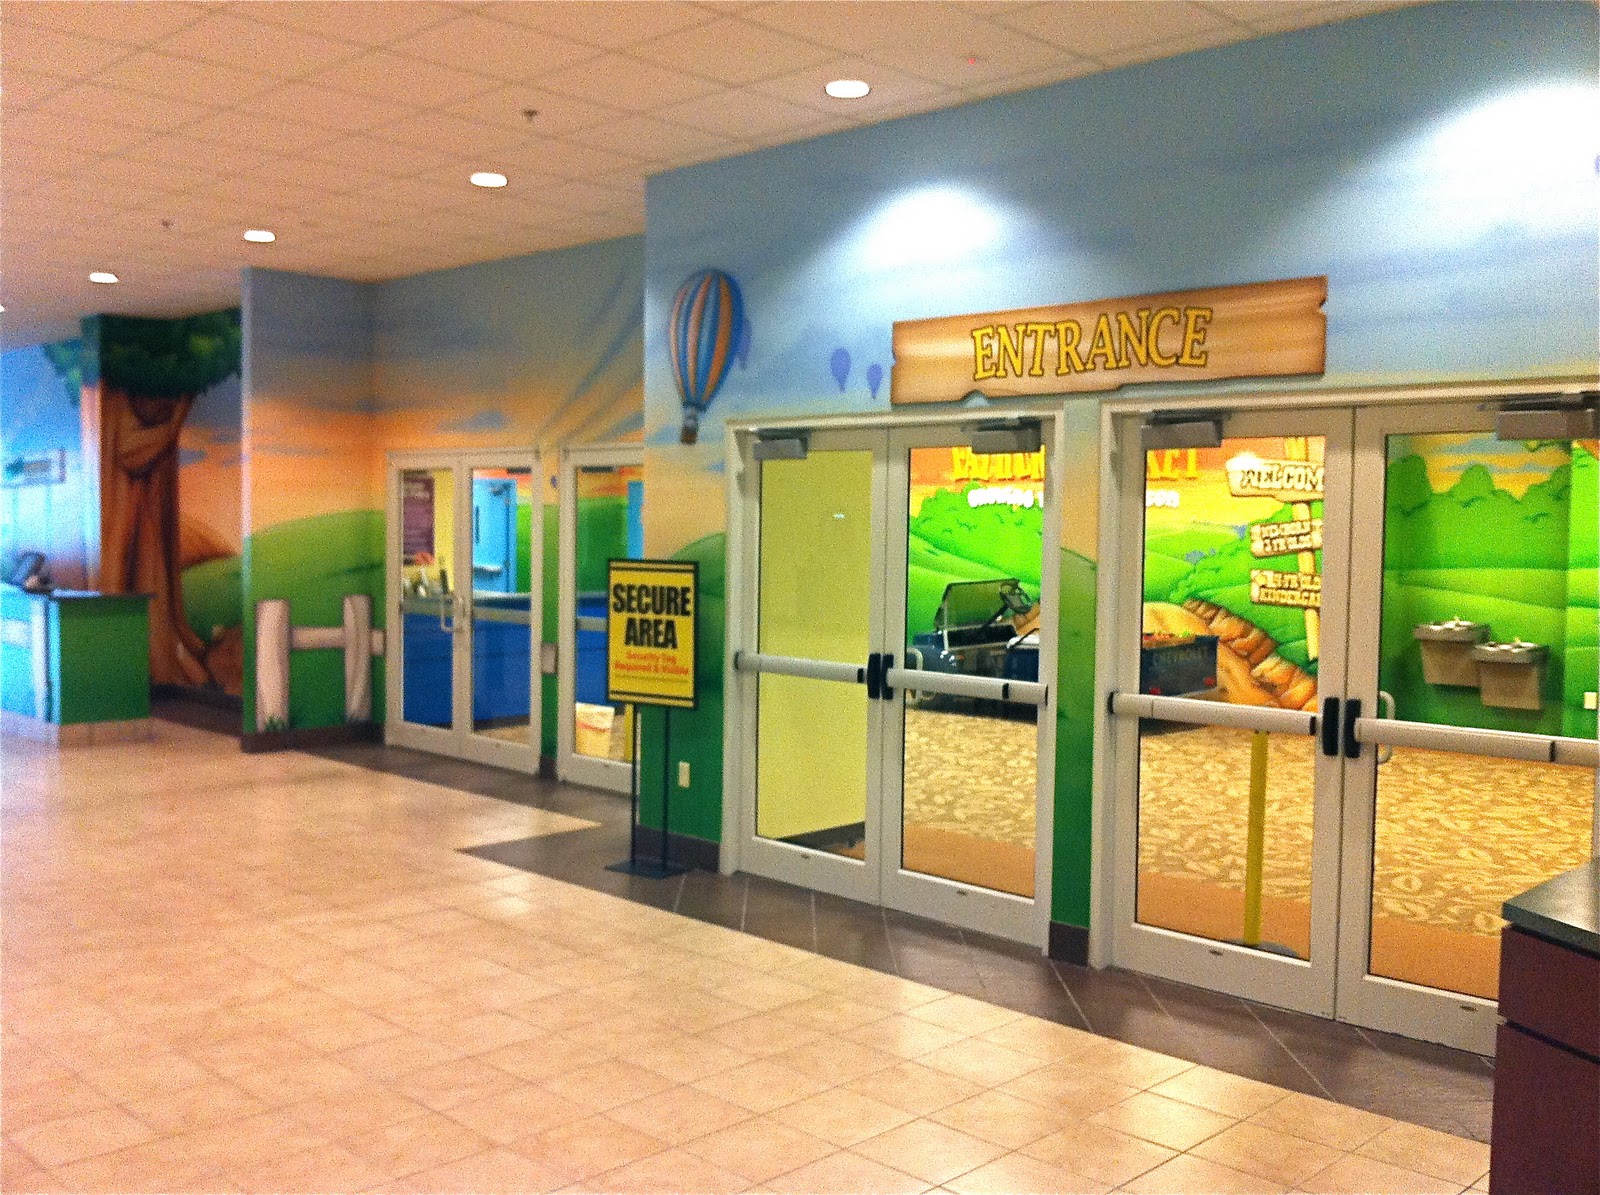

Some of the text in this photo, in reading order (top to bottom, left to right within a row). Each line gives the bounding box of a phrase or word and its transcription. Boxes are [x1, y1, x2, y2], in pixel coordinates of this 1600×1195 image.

[971, 306, 1213, 382] ENTRANCE
[1240, 464, 1325, 492] WELCOM
[613, 583, 690, 616] SECURE
[625, 617, 678, 649] AREA
